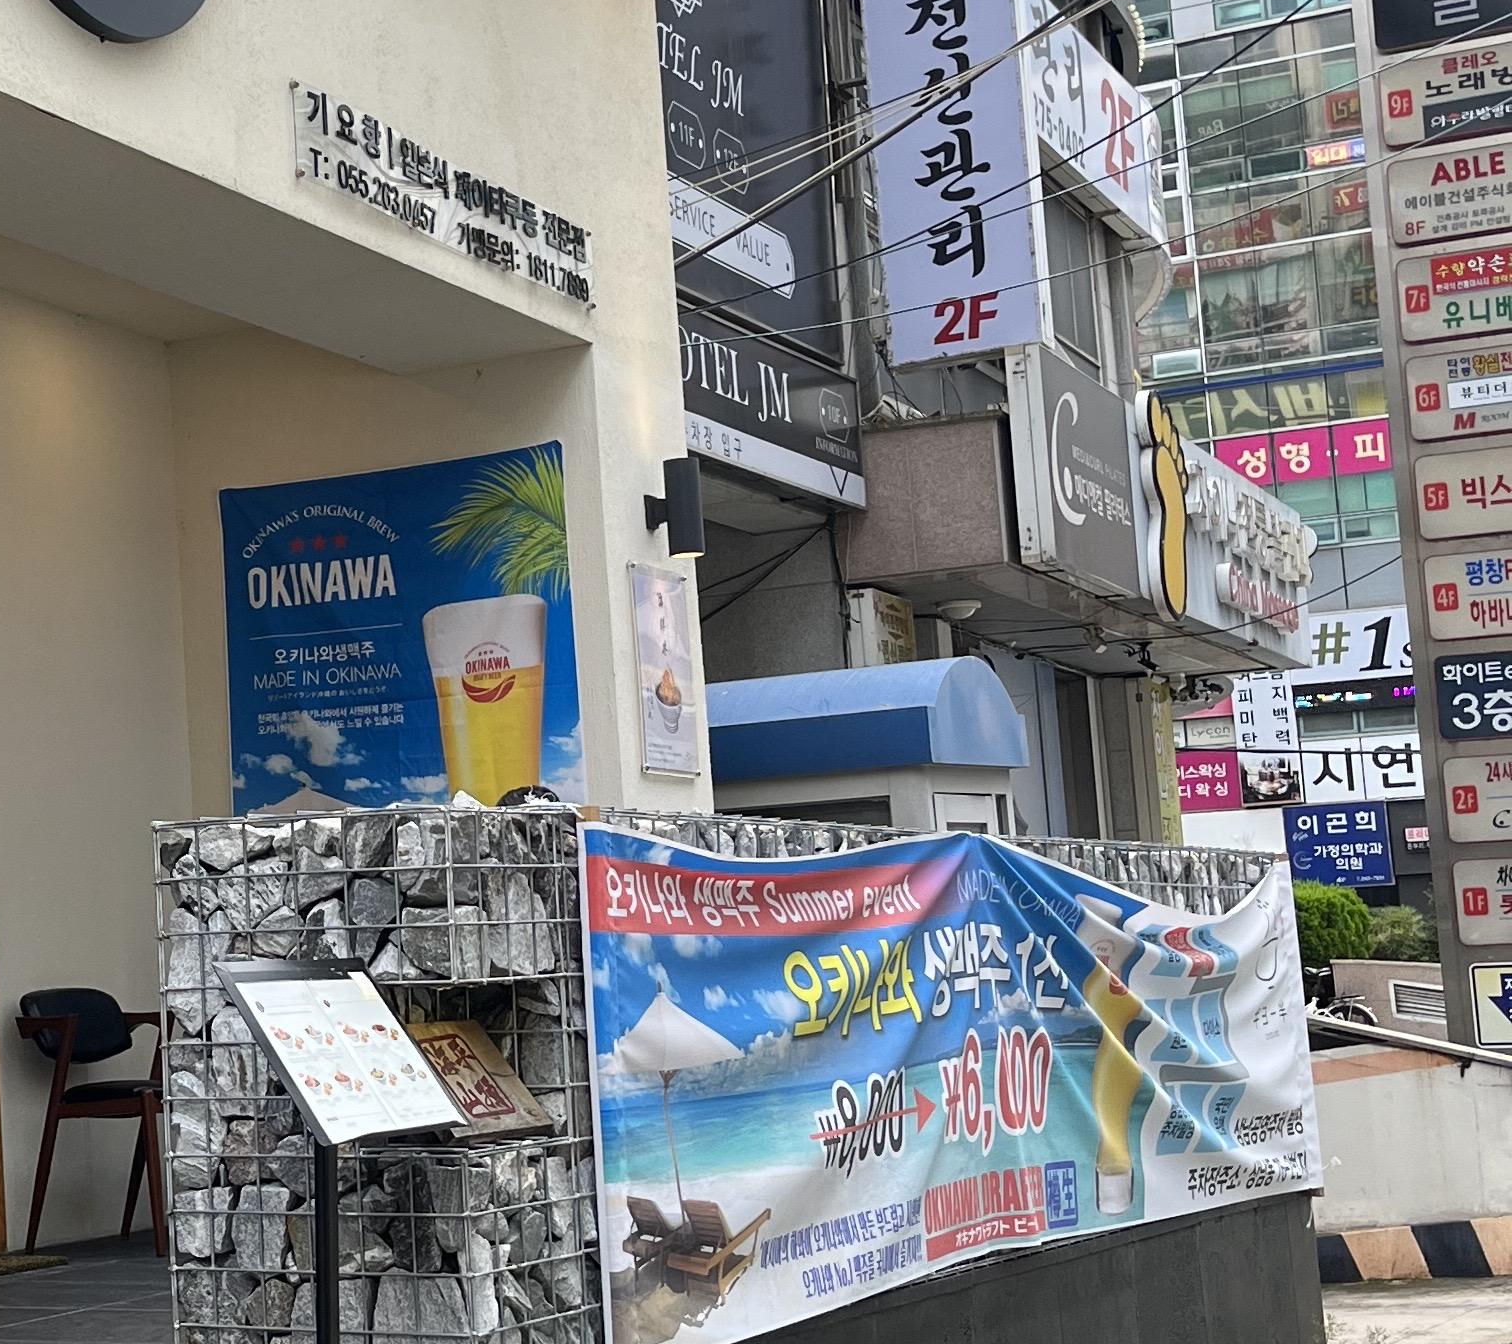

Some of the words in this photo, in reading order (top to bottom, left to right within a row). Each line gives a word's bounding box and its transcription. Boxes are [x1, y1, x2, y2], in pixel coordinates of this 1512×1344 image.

[710, 59, 744, 118] JM
[1391, 94, 1410, 115] 9F
[1100, 77, 1135, 194] 2F
[1431, 151, 1506, 187] ABLE
[1405, 220, 1426, 236] 8F
[1407, 288, 1428, 309] 7F
[933, 290, 1000, 345] 2F
[757, 361, 793, 424] JM
[1418, 387, 1438, 408] 6F
[685, 421, 714, 451] 차장
[1427, 487, 1447, 507] 5F
[303, 504, 364, 524] ORIGINAL
[246, 553, 397, 610] OKINAWA
[1436, 587, 1456, 607] 4F
[253, 670, 296, 690] MADE
[303, 669, 320, 686] IN
[325, 662, 402, 684] OKINAWA
[1452, 688, 1512, 733] 3층
[1455, 788, 1476, 810] 2F
[1297, 809, 1378, 837] 이곤희
[605, 867, 693, 926] 오키나와
[693, 876, 760, 928] 생맥주
[762, 880, 855, 926] Summer
[861, 874, 922, 916] event
[1466, 890, 1486, 912] 1F
[782, 937, 924, 1037] 오키나와
[923, 920, 1012, 1018] 생맥주
